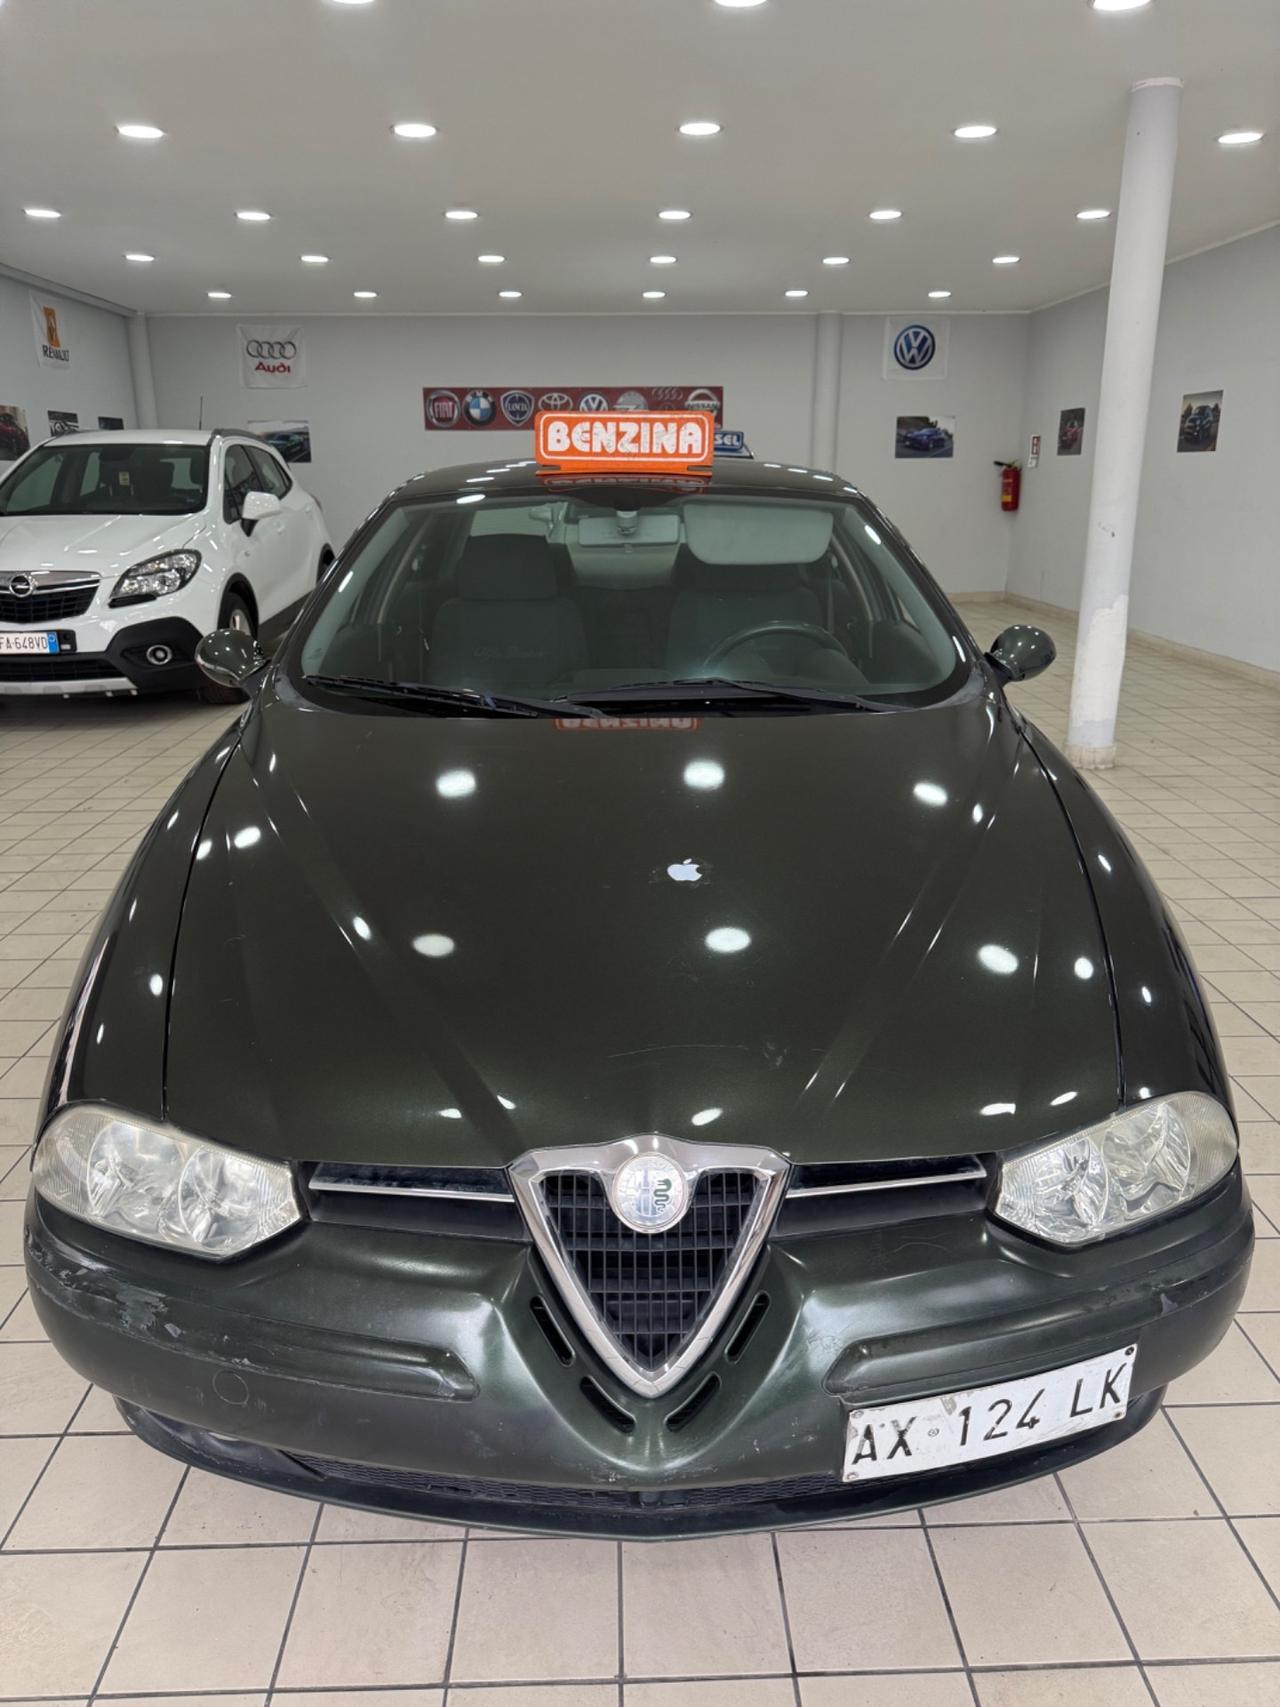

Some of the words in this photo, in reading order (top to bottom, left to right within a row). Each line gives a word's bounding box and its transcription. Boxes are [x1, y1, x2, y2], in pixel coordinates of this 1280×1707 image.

[255, 361, 291, 374] Audi
[434, 401, 454, 418] FIAT
[547, 420, 703, 454] BENZINA
[714, 433, 740, 446] SEL
[852, 1416, 917, 1465] AX
[959, 1388, 1045, 1447] 124
[1070, 1362, 1128, 1418] LK
